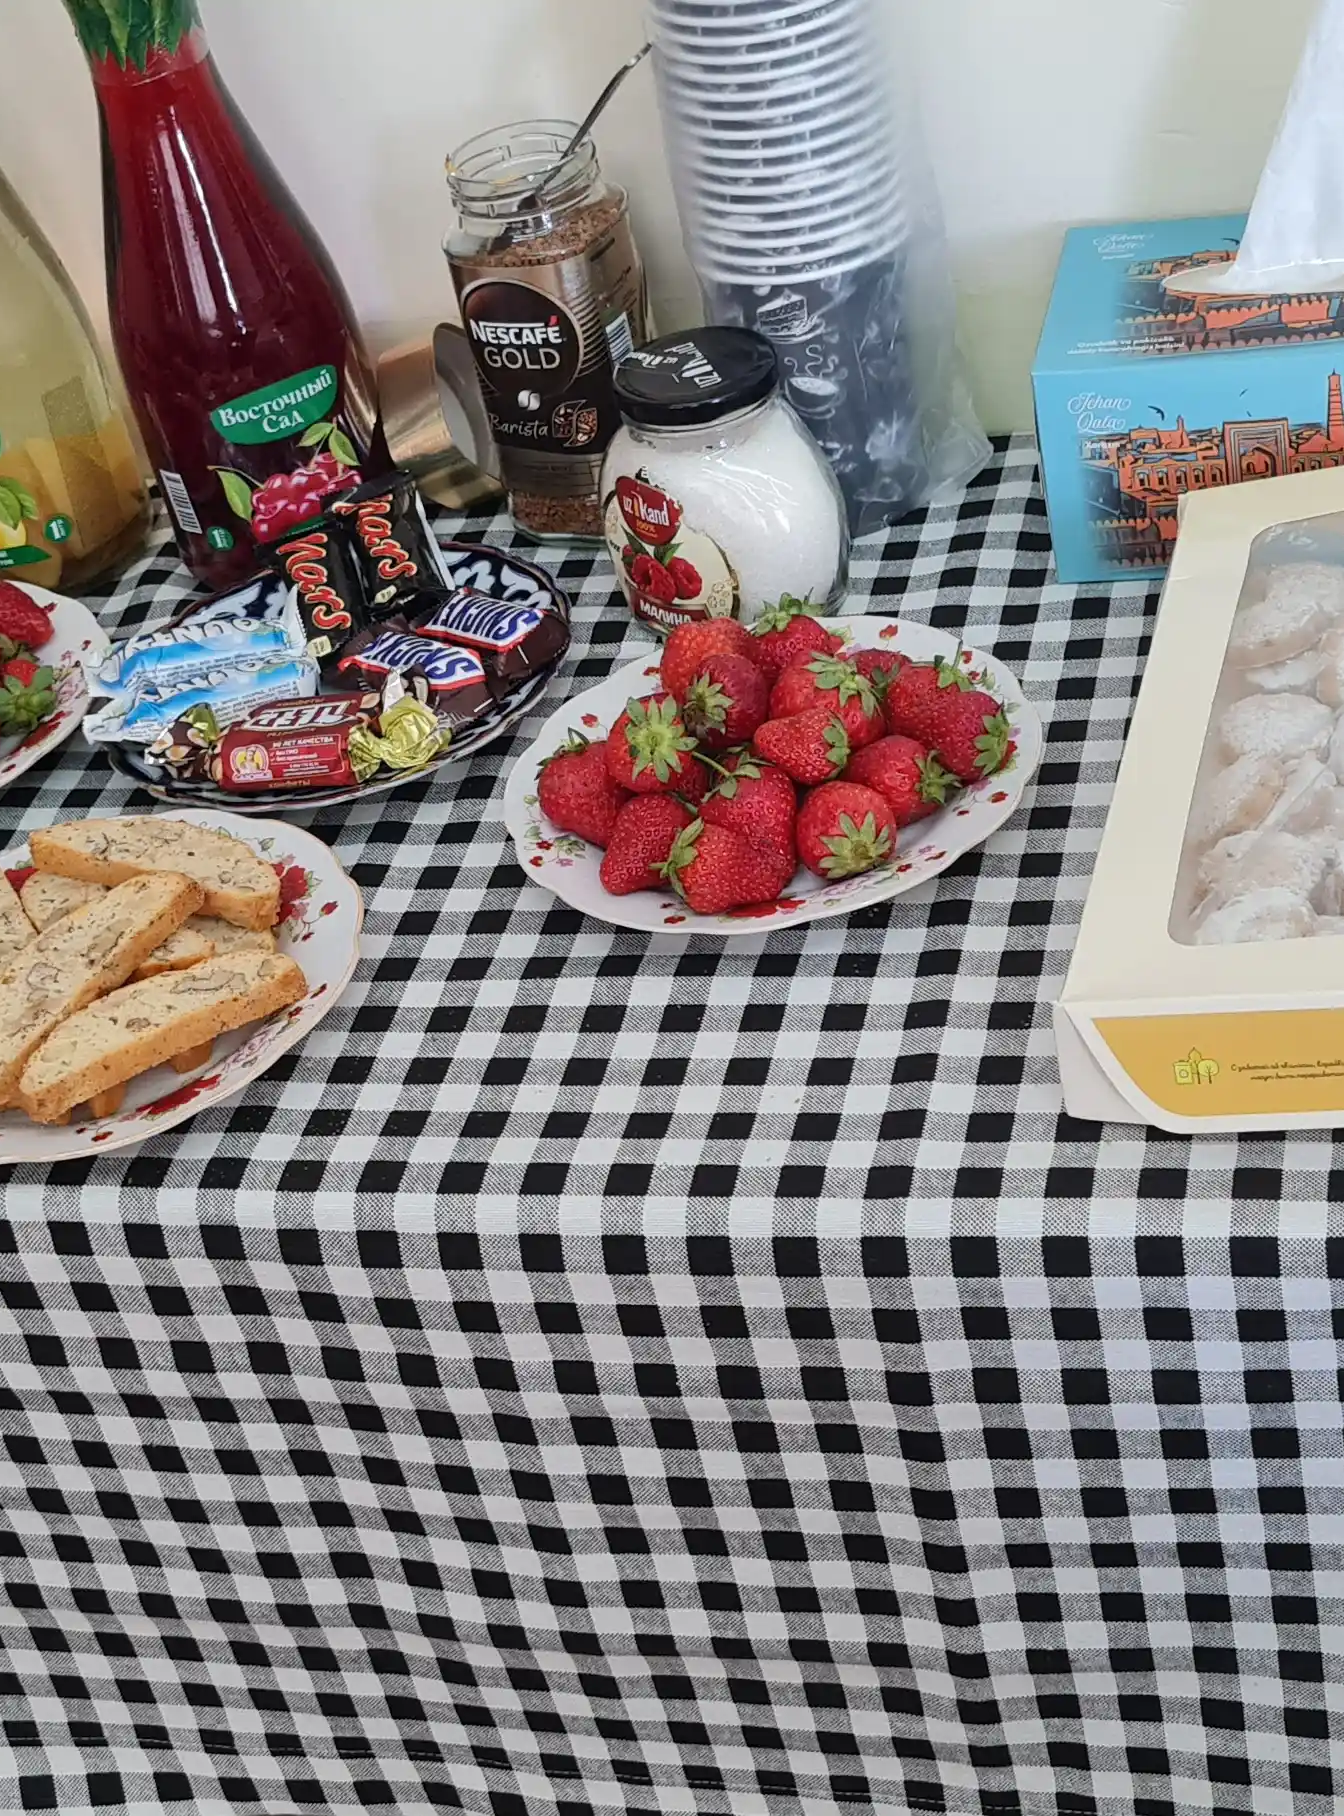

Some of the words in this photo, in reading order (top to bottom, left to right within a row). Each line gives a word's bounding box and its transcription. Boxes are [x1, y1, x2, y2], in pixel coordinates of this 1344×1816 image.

[469, 315, 564, 345] NESCAFÉ
[483, 346, 561, 371] GOLD
[218, 369, 334, 428] Восточный
[261, 409, 305, 434] Сад
[488, 412, 549, 439] Barista
[276, 532, 353, 631] Mars
